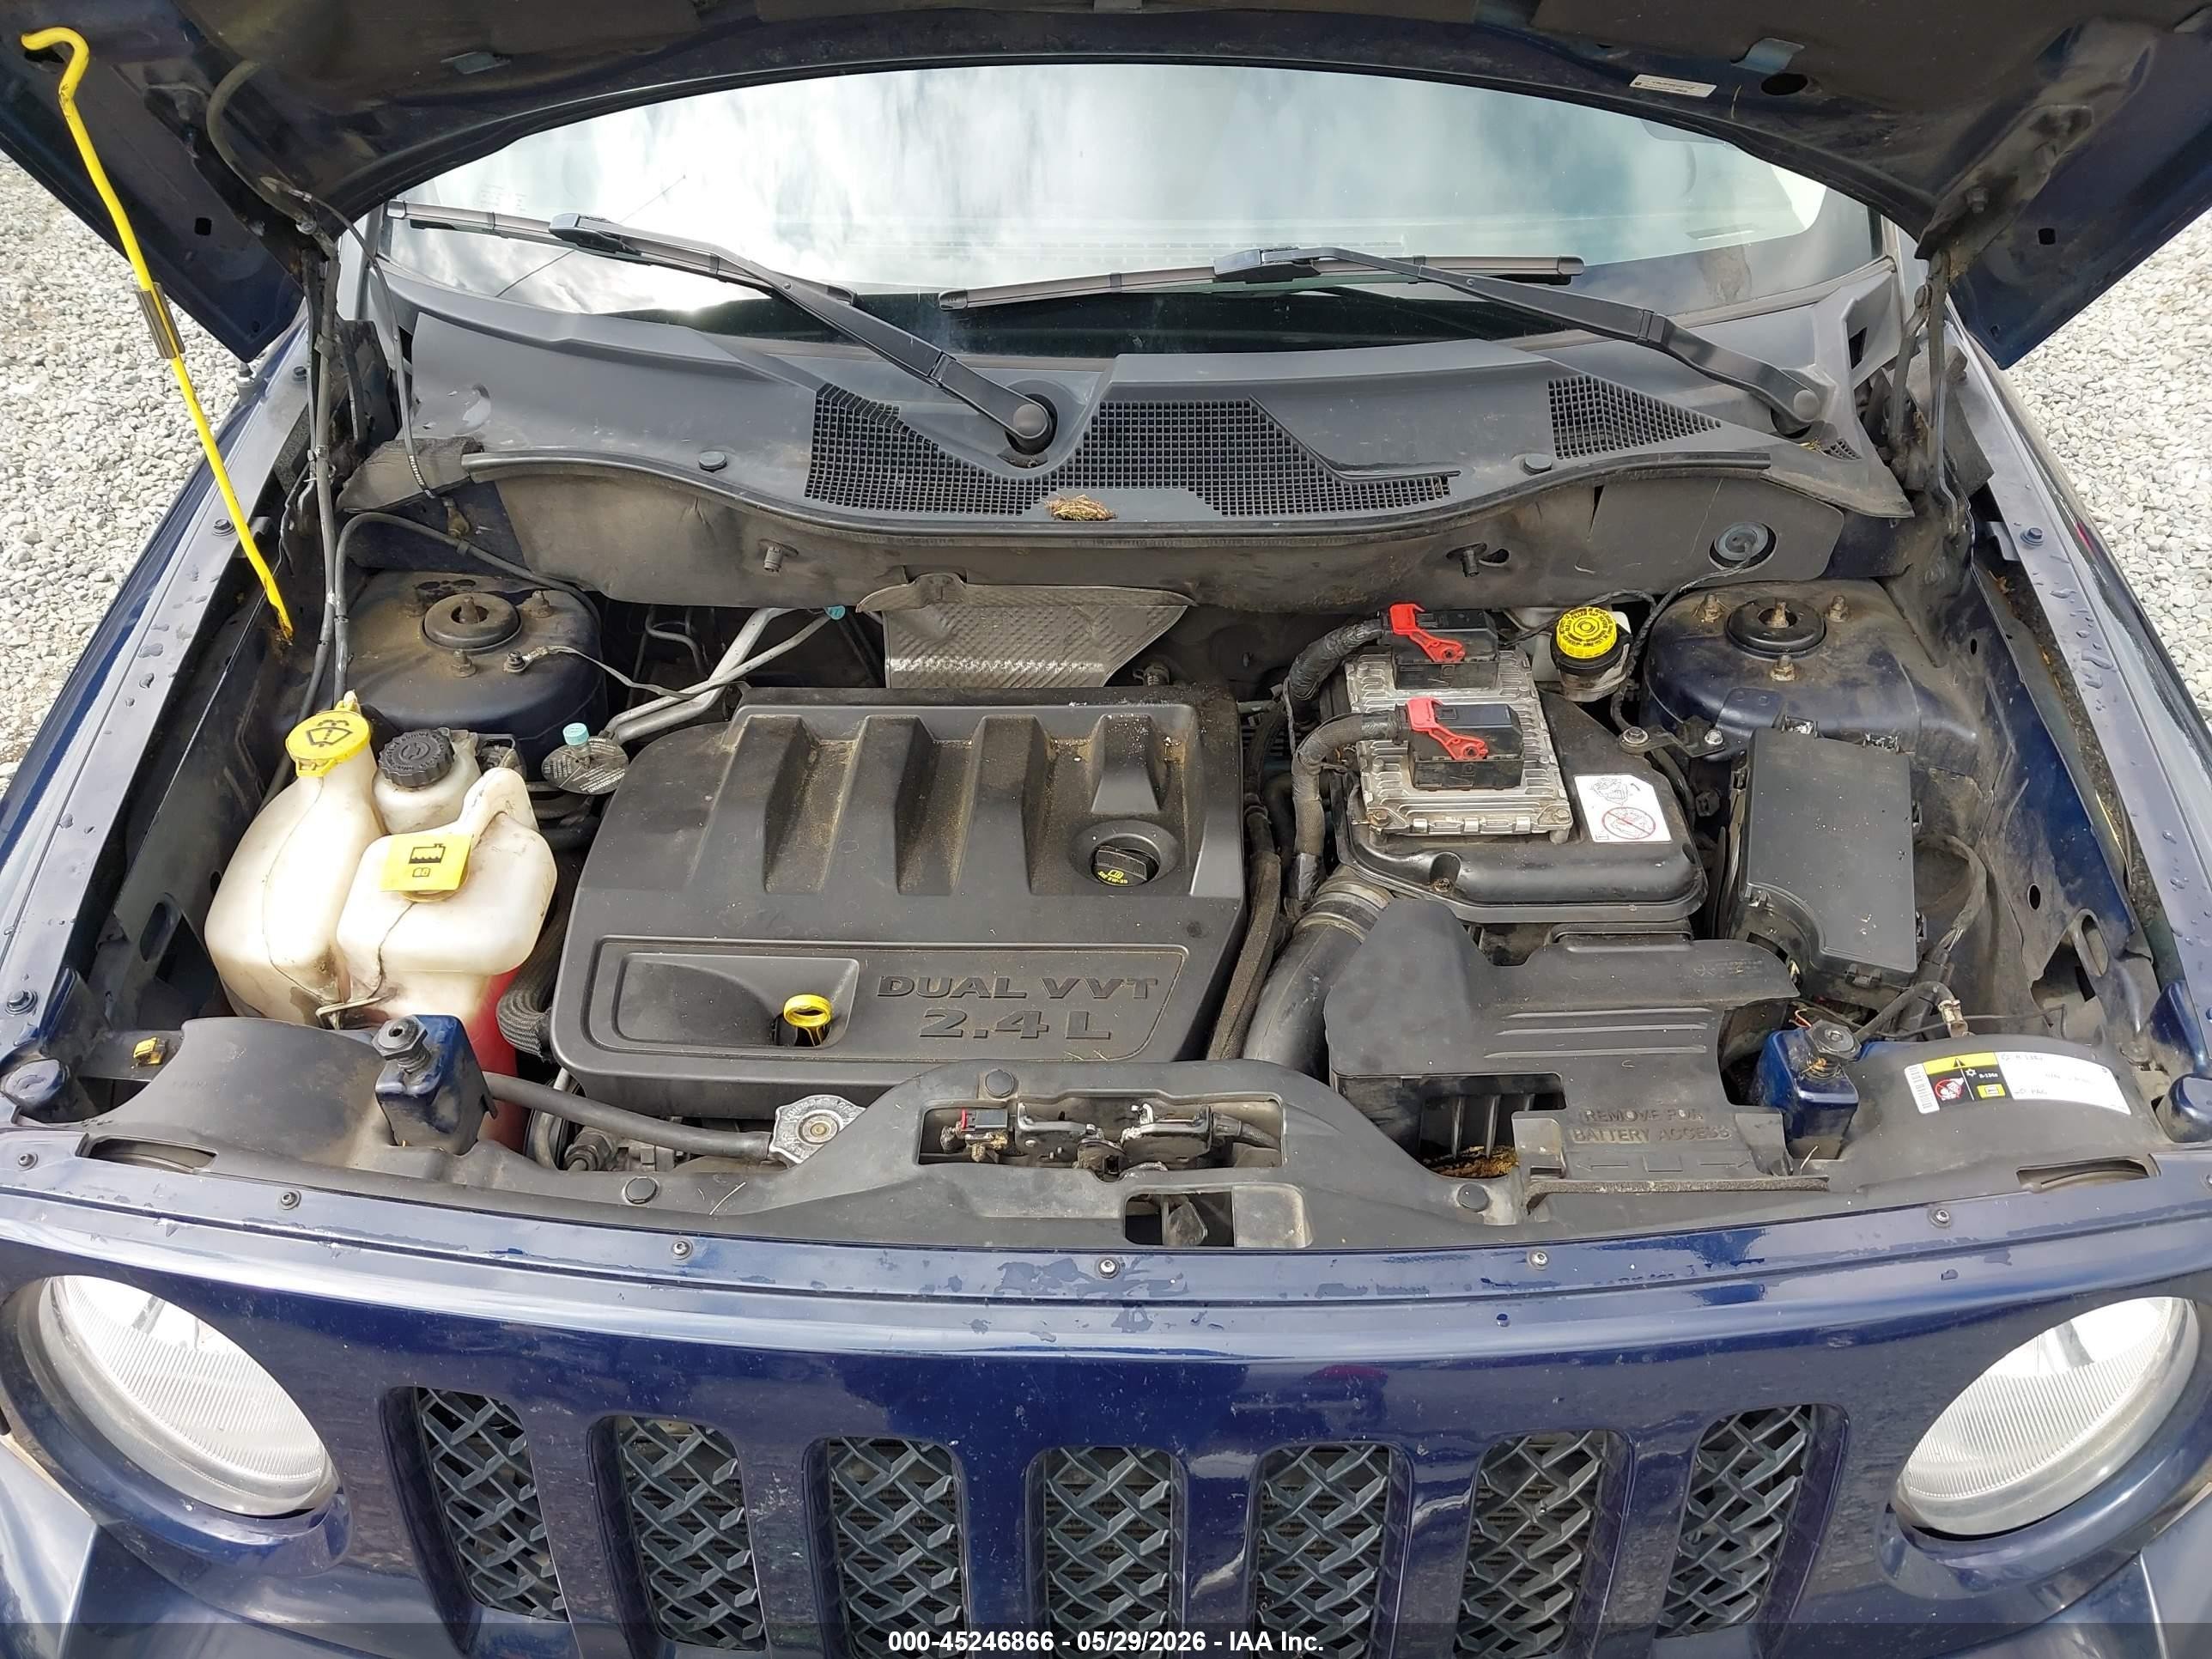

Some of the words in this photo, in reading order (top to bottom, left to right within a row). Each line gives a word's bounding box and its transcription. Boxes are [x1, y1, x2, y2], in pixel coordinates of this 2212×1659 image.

[877, 975, 1027, 999] DUAL
[1039, 976, 1158, 1000] VVT
[1585, 1109, 1658, 1122] REMOVE
[1572, 1127, 1650, 1143] BATTERY
[1658, 1126, 1732, 1141] ACCESS
